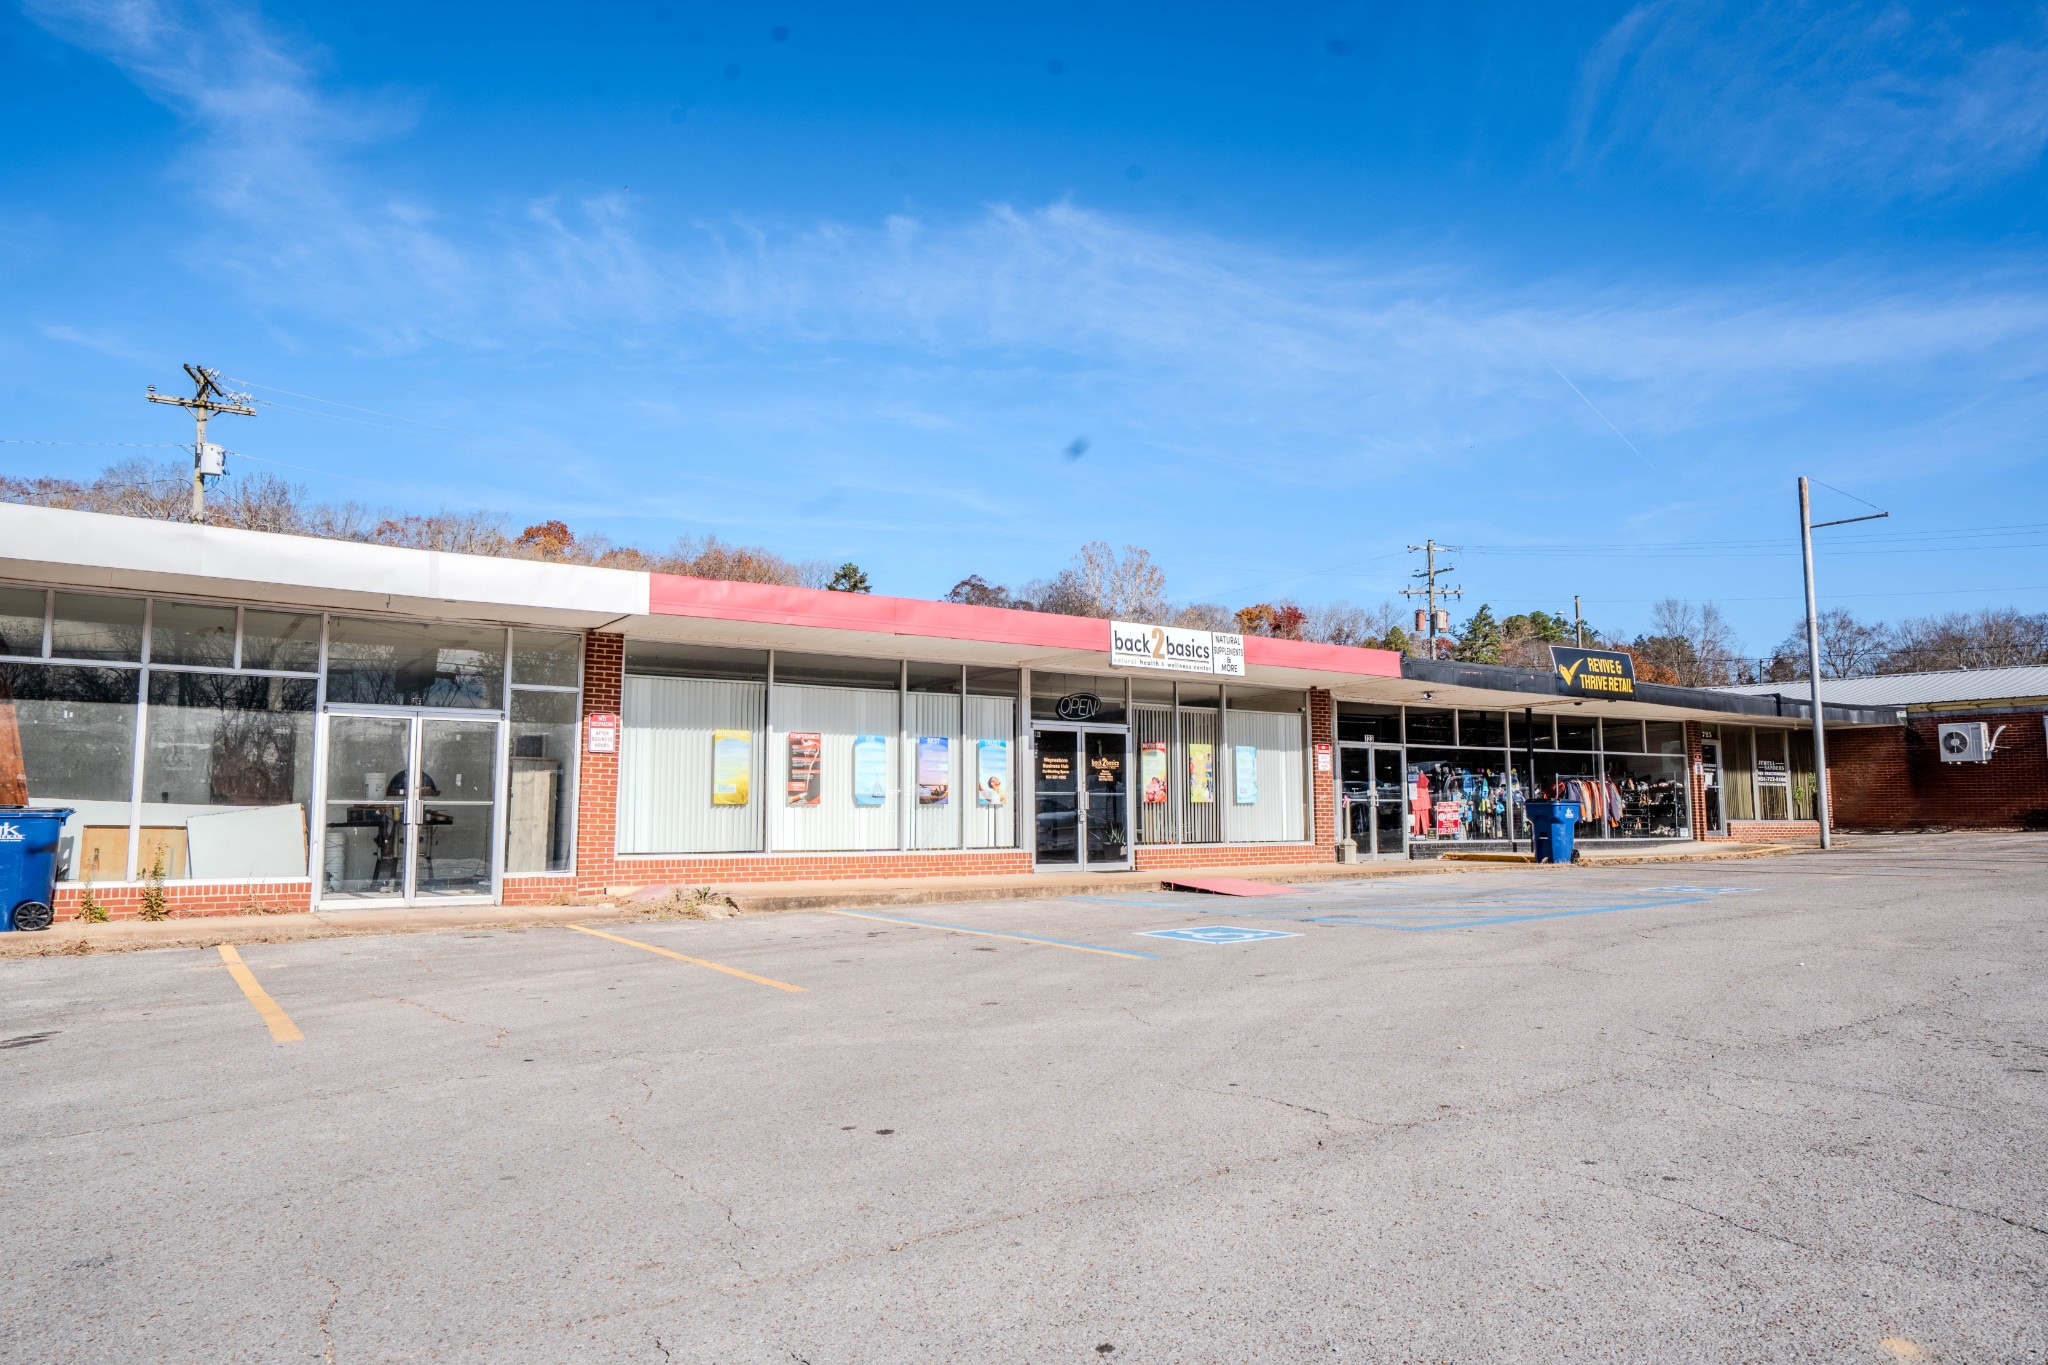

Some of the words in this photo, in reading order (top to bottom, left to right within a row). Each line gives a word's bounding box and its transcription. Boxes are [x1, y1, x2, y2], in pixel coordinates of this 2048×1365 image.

[1215, 635, 1241, 646] NATURAL
[1213, 646, 1244, 657] SUPPLEMENTS
[1167, 662, 1192, 670] wellness
[1221, 664, 1238, 673] MORE
[1587, 657, 1616, 674] REVIVE
[1615, 660, 1622, 674] &
[1579, 673, 1608, 690] THRIVE
[1608, 676, 1633, 692] RETAIL
[1060, 697, 1098, 716] OPEN
[927, 737, 940, 745] REST
